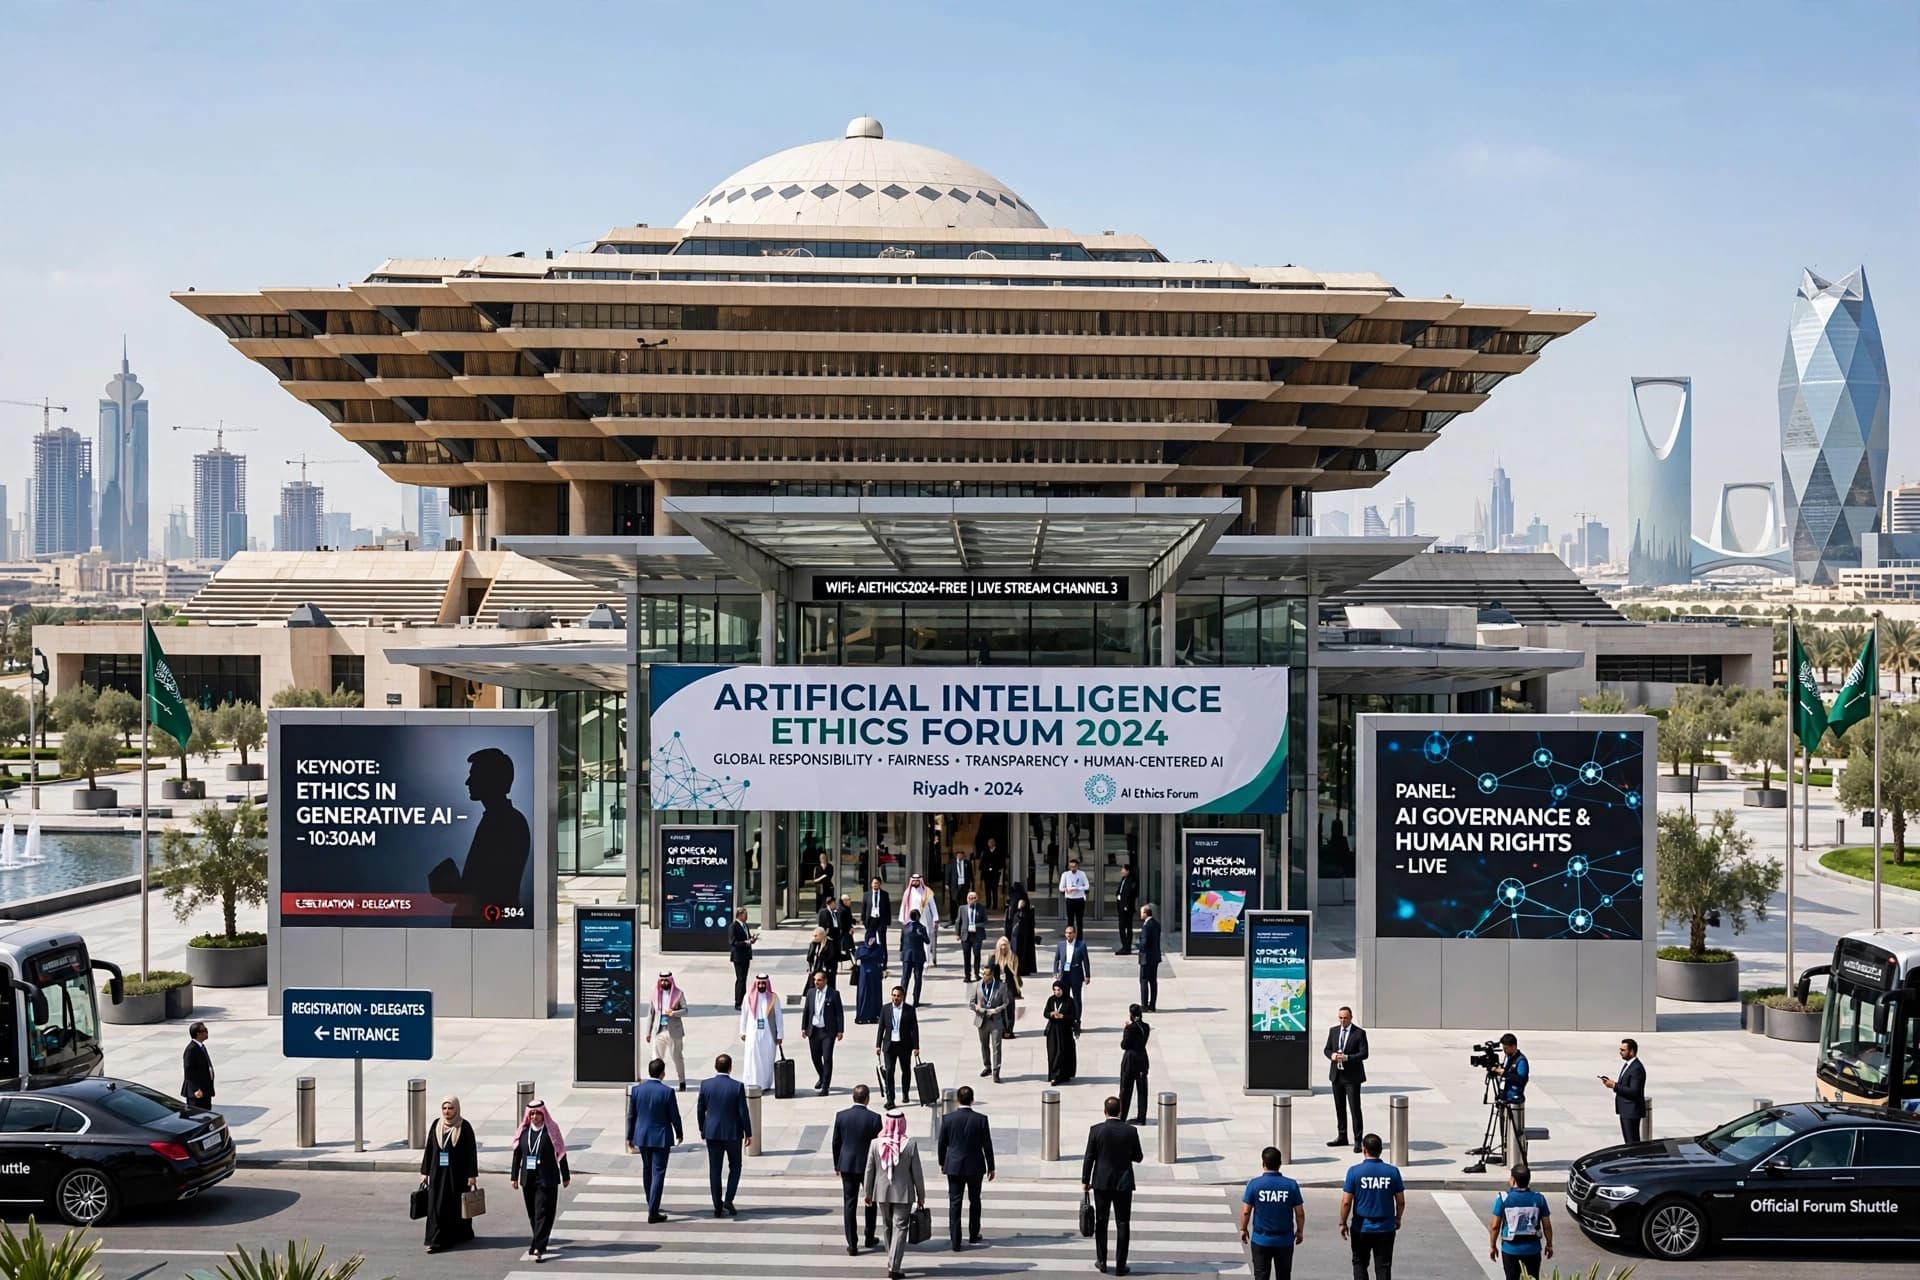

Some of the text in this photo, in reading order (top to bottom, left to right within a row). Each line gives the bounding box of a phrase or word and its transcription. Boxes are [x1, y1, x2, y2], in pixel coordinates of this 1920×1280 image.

[825, 581, 855, 594] WIFI:
[857, 581, 968, 594] AIETHICS2024-FREE
[977, 581, 1002, 594] LIVE
[1003, 581, 1051, 594] STREAM
[1052, 581, 1109, 595] CHANNEL
[1110, 581, 1119, 595] 3
[713, 683, 1222, 713] ARTIFICIAL INTELLIGENCE
[772, 717, 1169, 747] ETHICS FORUM 2024
[296, 759, 381, 775] KEYNOTE:
[713, 752, 766, 767] GLOBAL
[768, 753, 873, 767] RESPONSIBILITY
[888, 753, 950, 767] FAIRNESS
[964, 754, 1069, 768] TRANSPARENCY
[1083, 755, 1208, 769] HUMAN-CENTERED
[1210, 755, 1224, 769] AI
[296, 781, 397, 801] ETHICS IN
[913, 780, 969, 800] Riyadh
[984, 781, 1024, 797] 2024
[1120, 787, 1199, 799] AI Ethics Forum
[1396, 783, 1456, 799] PANEL:
[296, 806, 426, 825] GENERATIVE
[430, 806, 452, 825] AI
[1395, 807, 1591, 826] AI GOVERNANCE &
[308, 830, 376, 846] 10:30AM
[1396, 831, 1572, 852] HUMAN RIGHTS
[1408, 857, 1447, 874] LIVE
[361, 899, 412, 910] DELEGATES
[291, 1002, 362, 1016] REGISTRATION
[370, 1003, 426, 1016] DELEGATES
[333, 1026, 400, 1042] ENTRANCE
[0, 1161, 31, 1175] uttle
[1360, 1176, 1391, 1190] STAFF
[1258, 1189, 1289, 1203] STAFF
[1750, 1198, 1899, 1213] Official Forum Shuttle
